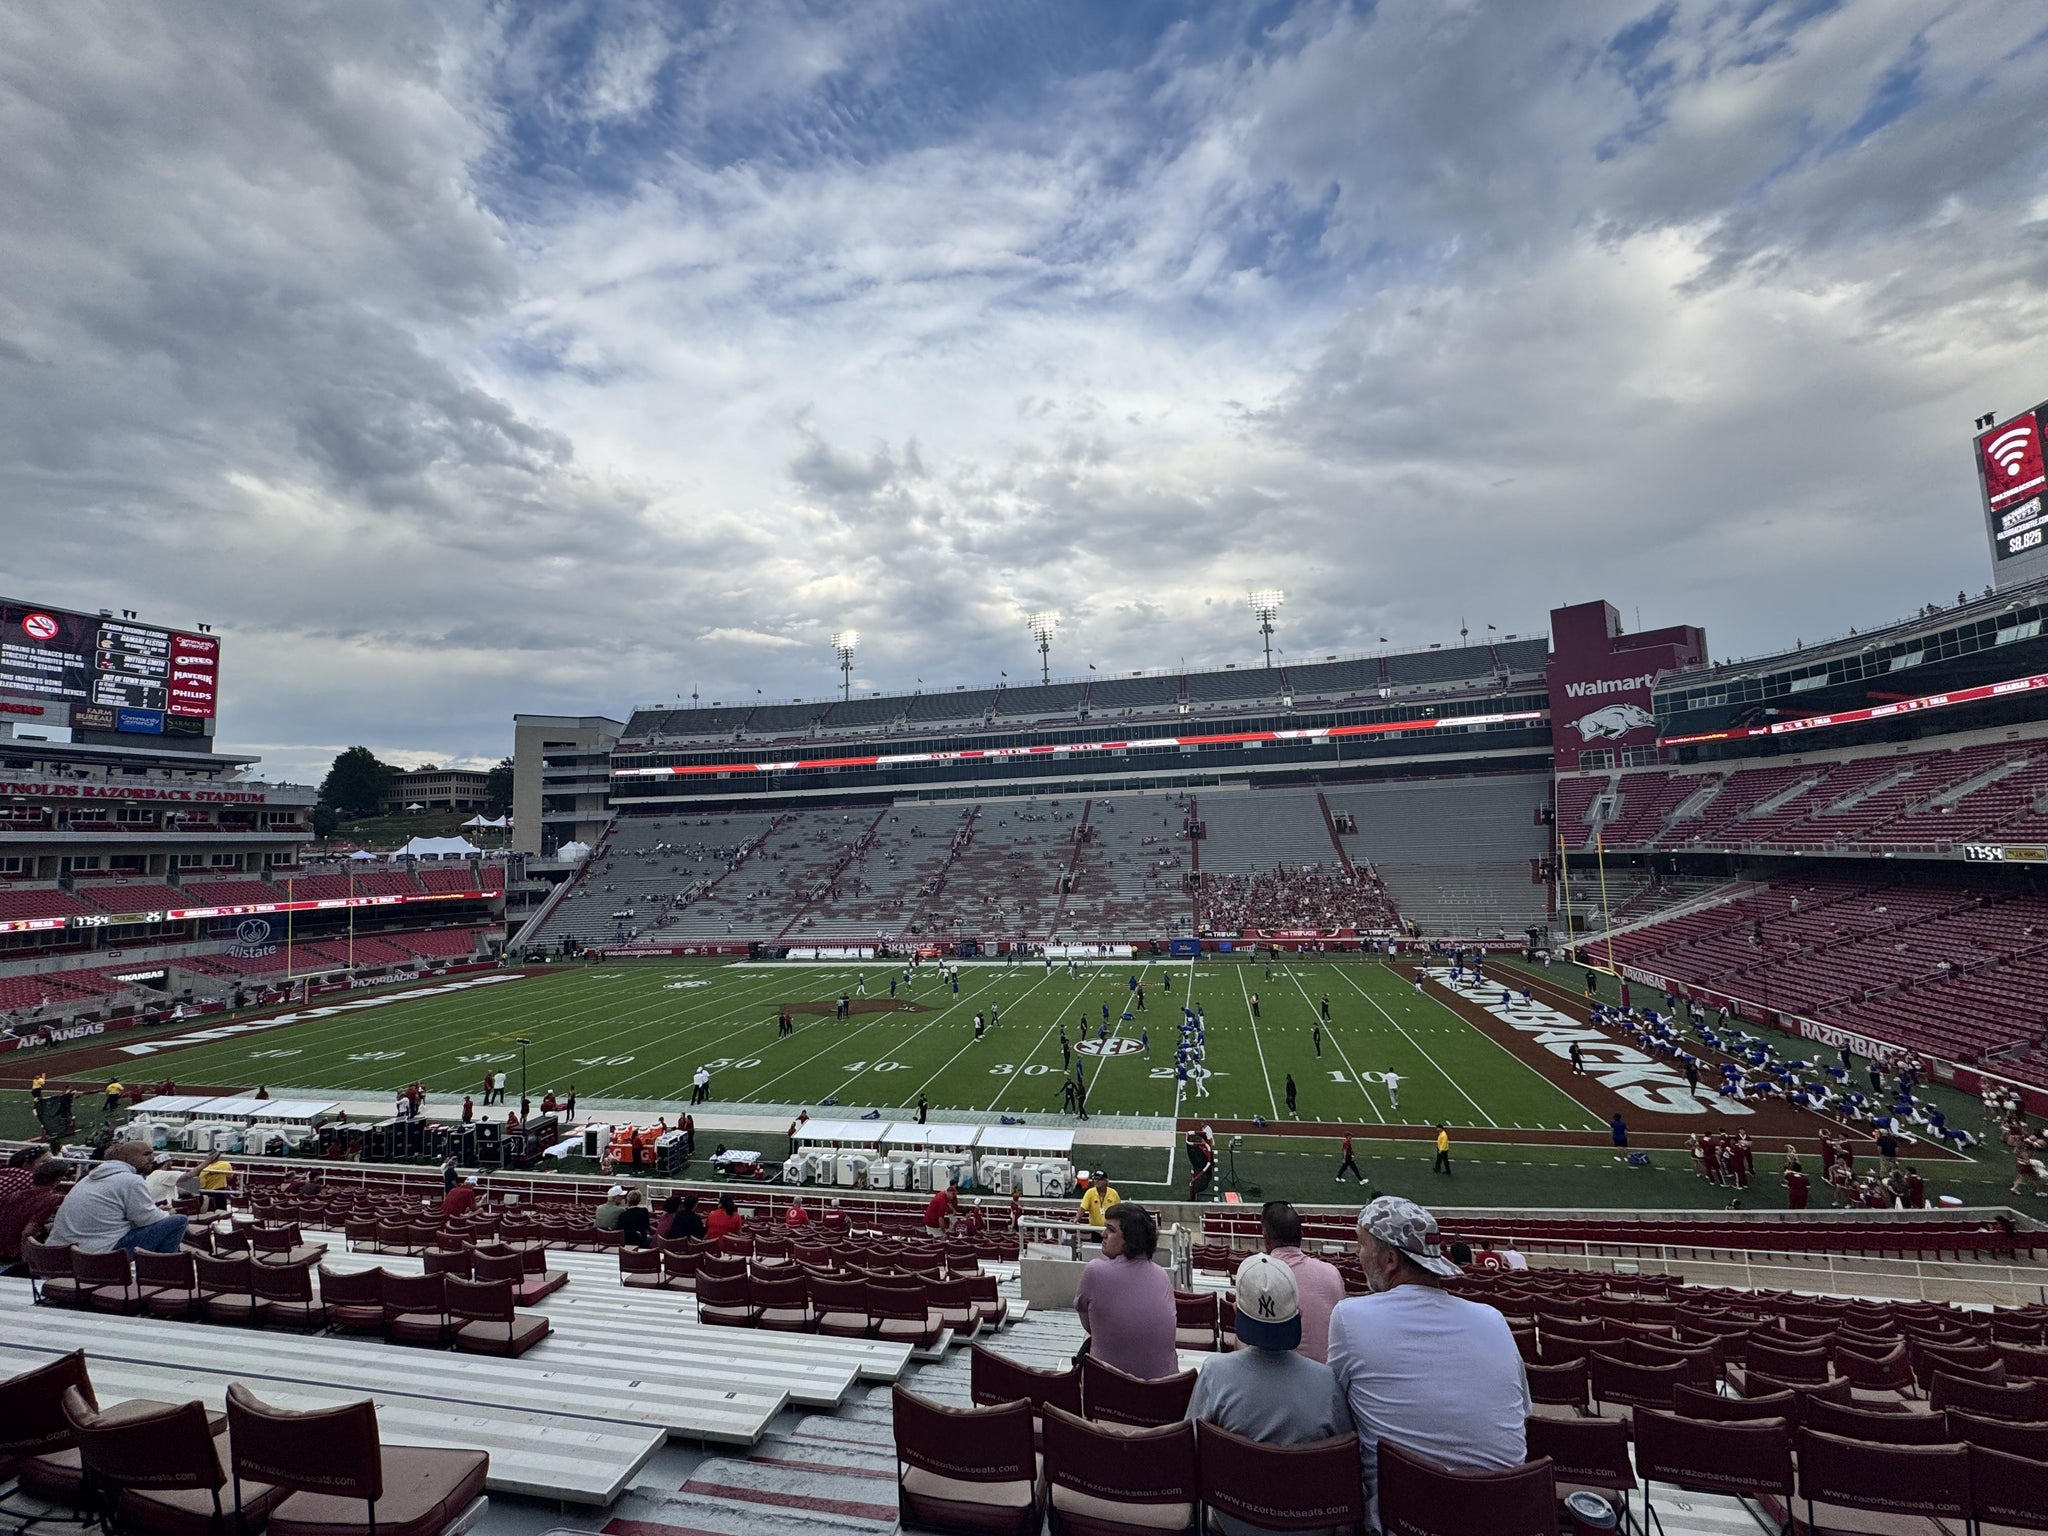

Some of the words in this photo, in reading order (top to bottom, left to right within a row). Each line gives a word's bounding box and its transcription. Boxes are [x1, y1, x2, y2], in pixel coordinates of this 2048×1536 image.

[2009, 528, 2042, 552] $8,825
[1, 651, 28, 661] STRICTLY
[29, 655, 63, 665] PROHIBITED
[37, 648, 63, 659] TOBACCO
[175, 656, 213, 665] OREO
[1, 658, 36, 669] RAZORBACK
[37, 663, 63, 673] STADIUM
[14, 675, 43, 684] INCLUDES
[173, 670, 213, 686] MAVERIK
[0, 680, 35, 690] ELECTRONIC
[63, 688, 87, 697] DEVICES
[1565, 673, 1654, 698] Walmart
[1993, 680, 2030, 694] ARKANSAS
[172, 689, 212, 700] PHILIPS
[75, 712, 113, 722] BUREAU
[87, 707, 112, 716] FARM
[182, 706, 202, 714] Google
[83, 786, 192, 801] RAZORBACK
[195, 790, 265, 803] STADIUM
[1966, 846, 2003, 860] 77:54
[76, 915, 109, 927] 77:54
[146, 911, 160, 922] 25
[225, 944, 278, 959] Allstate
[1622, 966, 1668, 991] ARKANSAS
[16, 1022, 105, 1050] ARANSAS
[1080, 1038, 1143, 1055] SEC
[576, 1055, 635, 1067] 40
[704, 1058, 762, 1069] 50
[842, 1061, 900, 1072] 40
[989, 1064, 1049, 1076] 30
[1326, 1070, 1390, 1084] 10
[640, 1149, 650, 1161] G
[1258, 1294, 1276, 1318] NY
[905, 1447, 1019, 1474] www.razorbackseats.com
[1058, 1470, 1183, 1496] www.razorbackseats.com
[1653, 1464, 1782, 1488] www.razorbackseats.com
[1213, 1488, 1349, 1518] www.razorbackseats.com
[1821, 1487, 1961, 1512] www.razorbackseats.com
